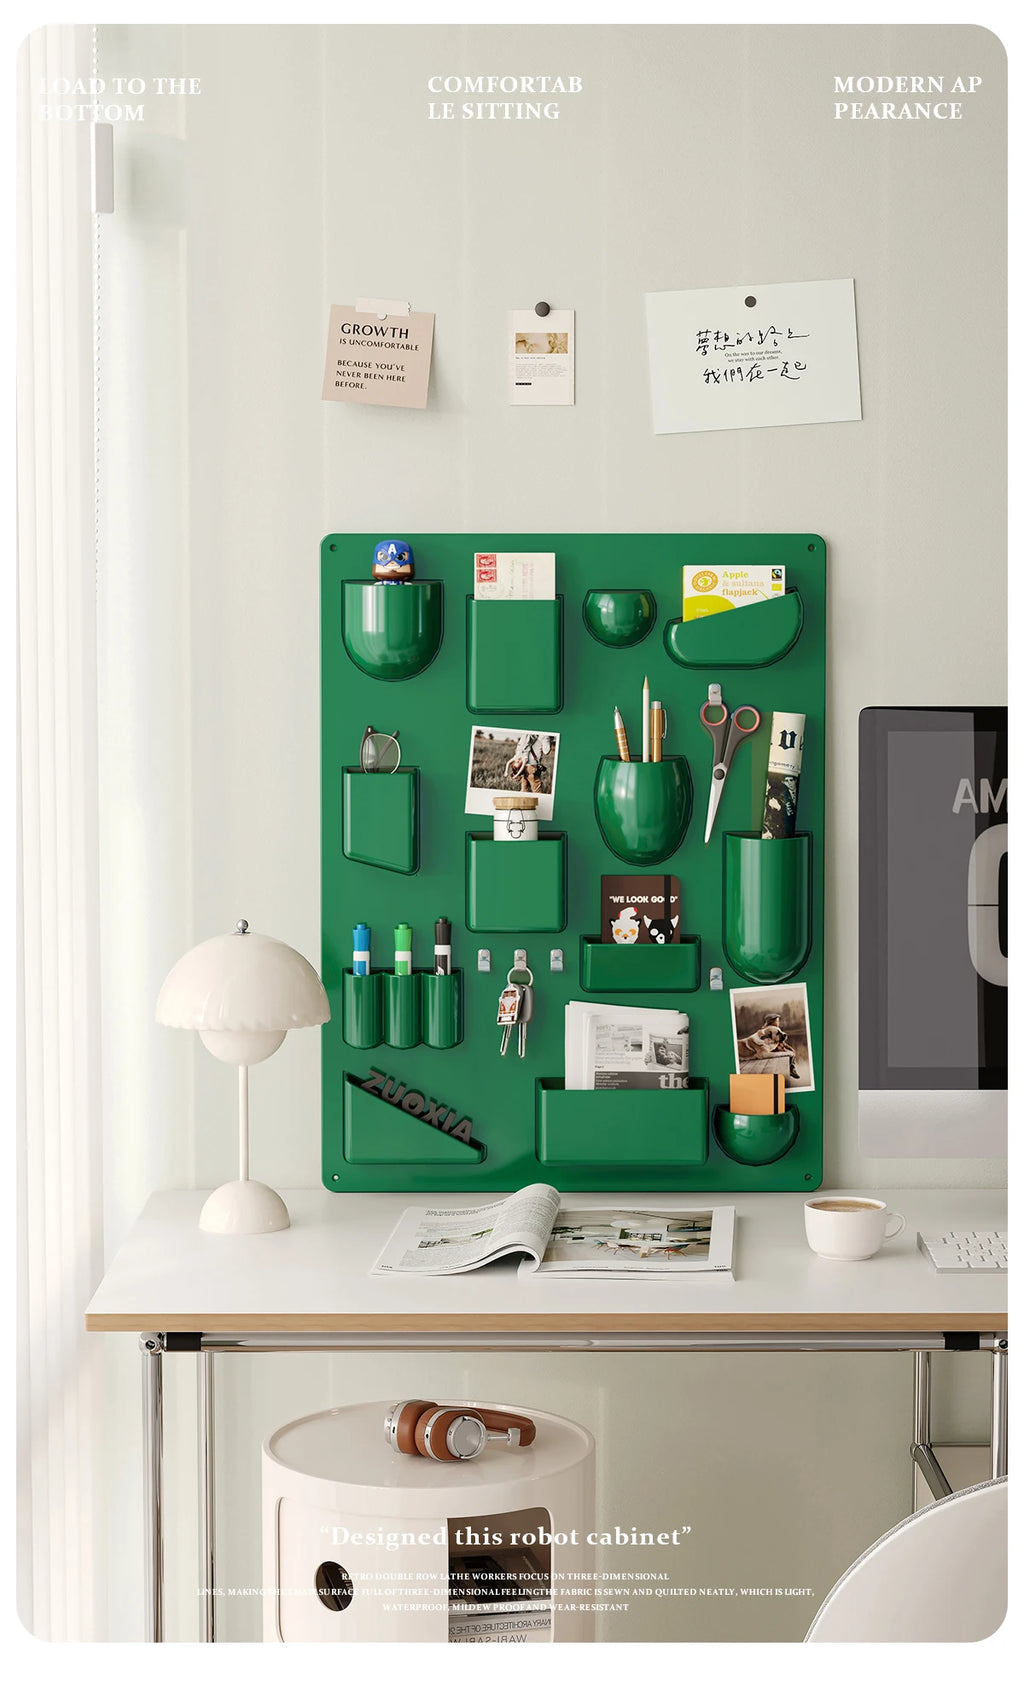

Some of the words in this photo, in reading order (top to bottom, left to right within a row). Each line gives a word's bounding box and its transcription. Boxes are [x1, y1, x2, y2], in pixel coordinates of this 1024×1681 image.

[340, 322, 409, 340] GROWTH
[339, 337, 347, 345] IS
[349, 338, 420, 352] UNCOMFORTABLE
[337, 359, 373, 369] BECAUSE
[375, 362, 406, 372] YOU'VE
[336, 370, 362, 378] NEVER
[363, 372, 385, 381] BEEN
[386, 374, 407, 383] HERE
[335, 380, 367, 390] BEFORE.
[722, 571, 749, 579] Apple
[721, 588, 759, 597] flapjack
[626, 895, 649, 903] LOOK
[651, 895, 679, 903] GOD"
[360, 1067, 473, 1145] ZUOXIA
